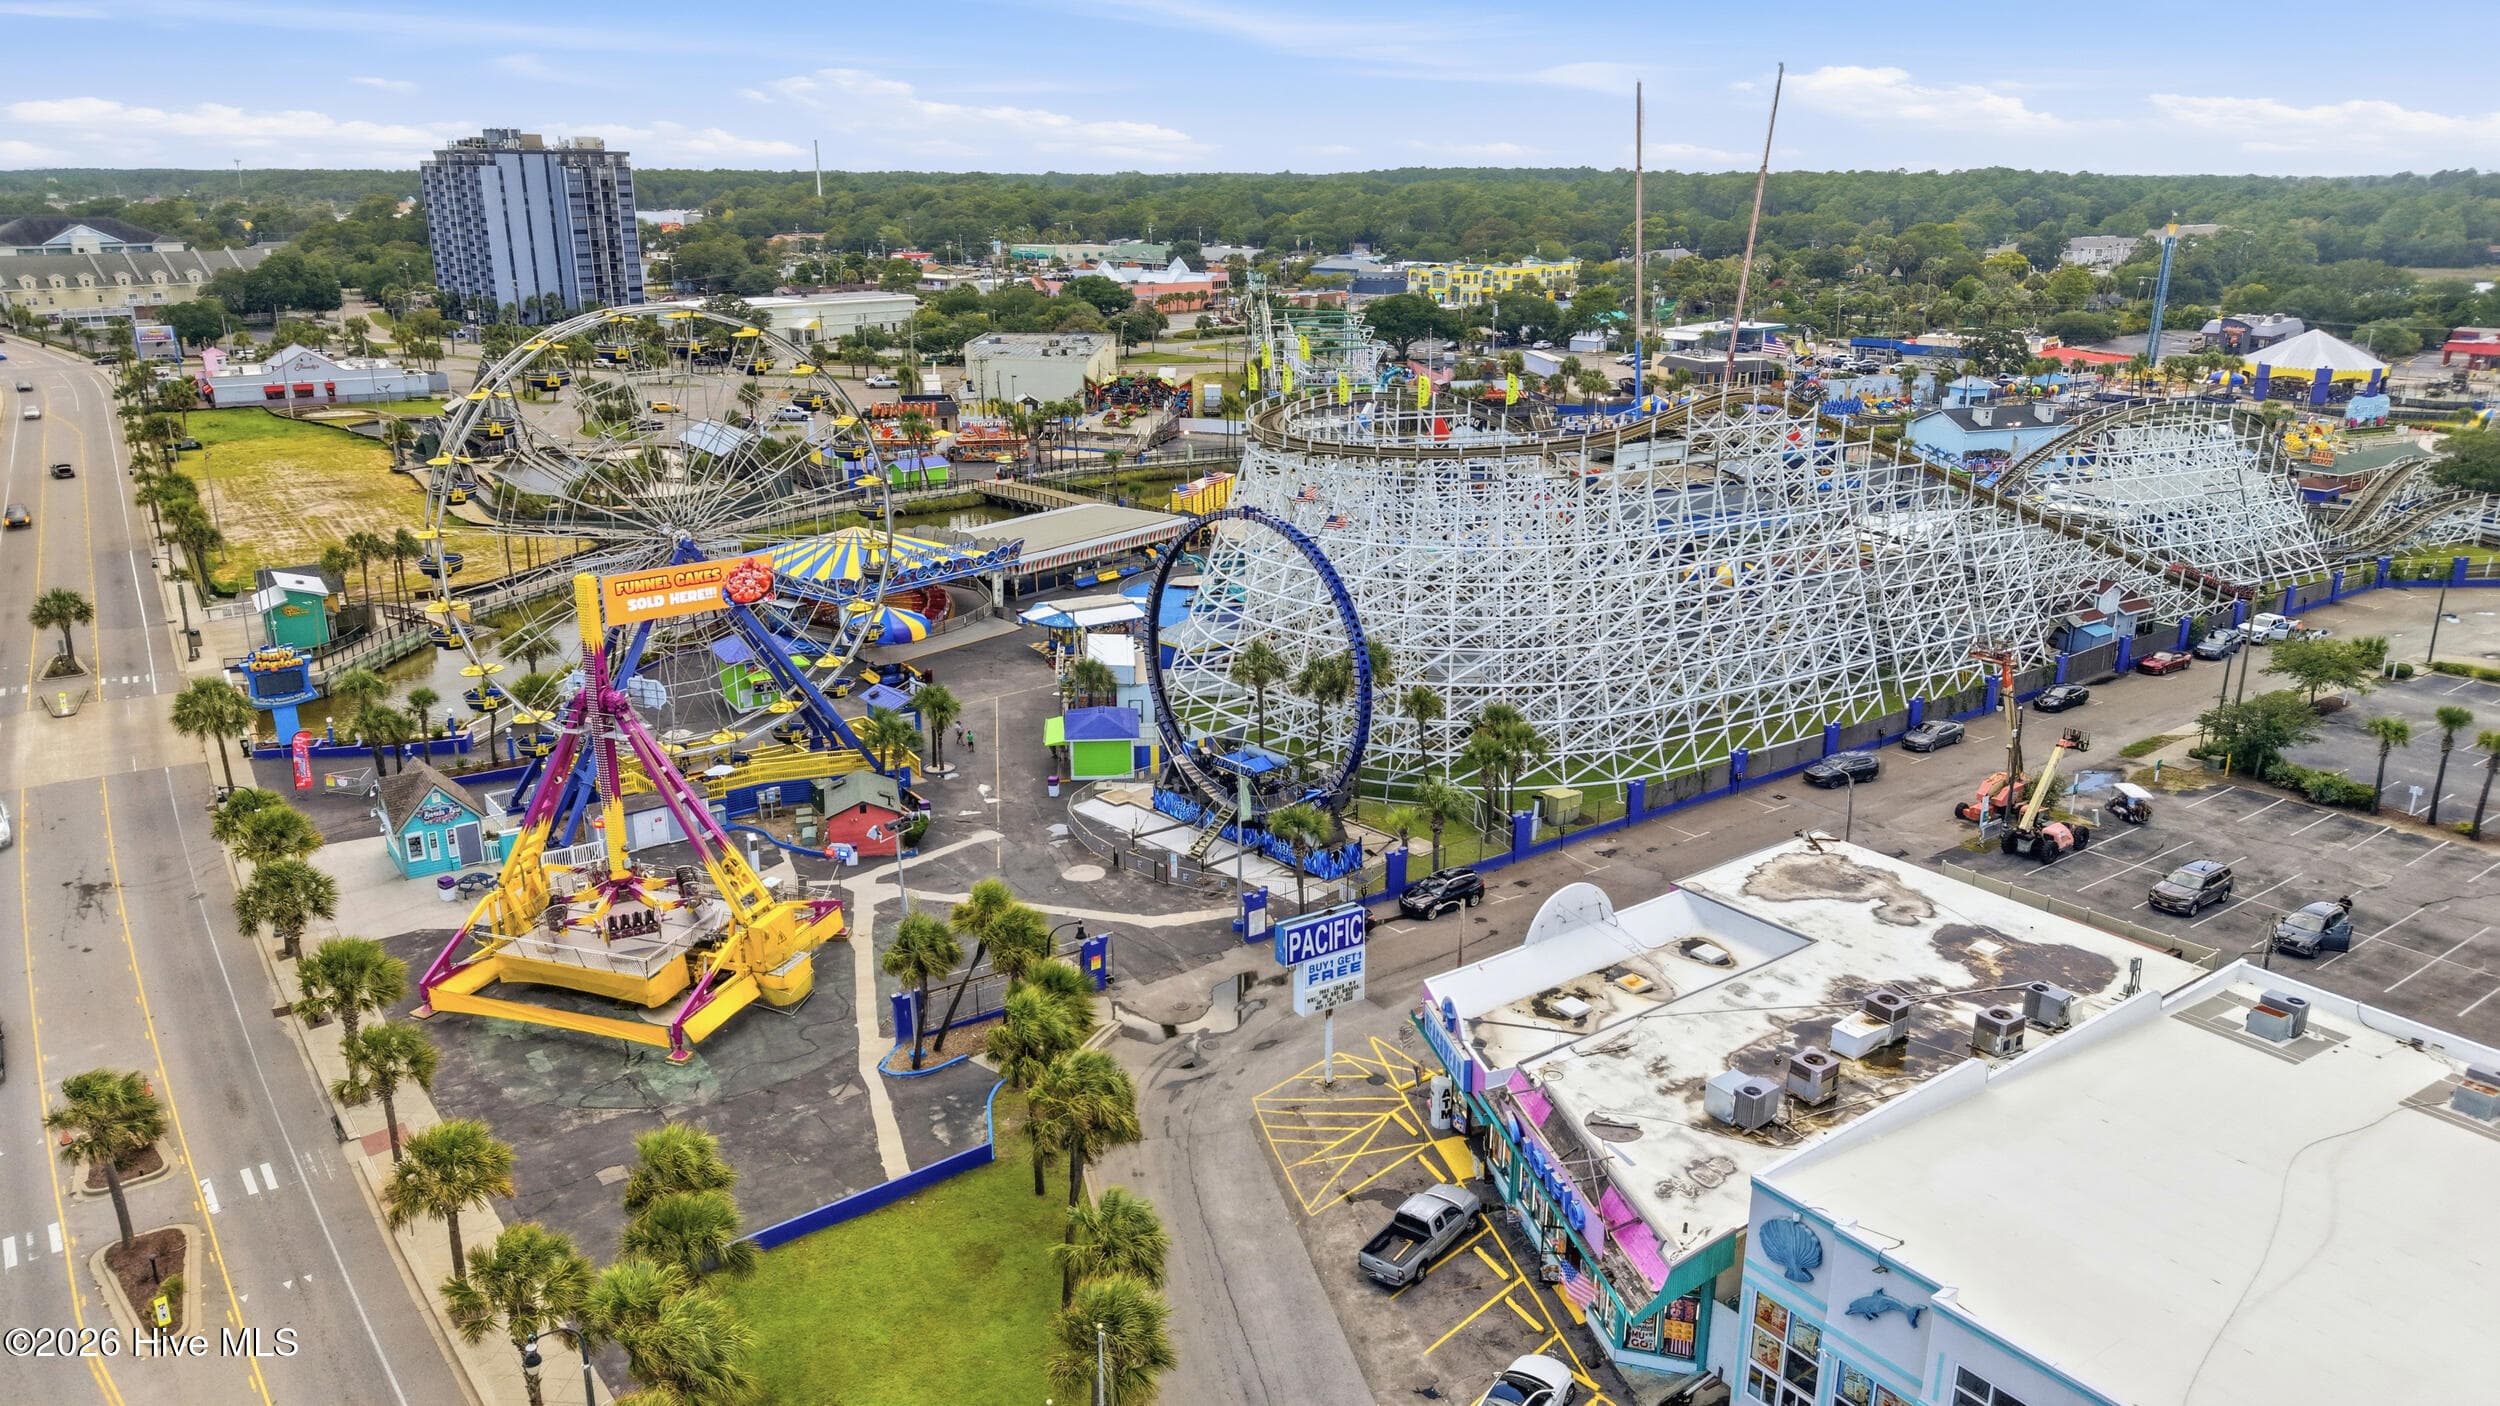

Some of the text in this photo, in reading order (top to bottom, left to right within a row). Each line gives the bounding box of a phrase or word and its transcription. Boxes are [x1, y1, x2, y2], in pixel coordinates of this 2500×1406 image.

[615, 567, 722, 596] FUNNEL CAKES
[627, 587, 718, 612] SOLD HERE!!!
[249, 657, 304, 673] Kingdom
[1289, 914, 1363, 963] PACIFIC
[1308, 961, 1361, 986] FREE
[1441, 1088, 1452, 1120] ATM
